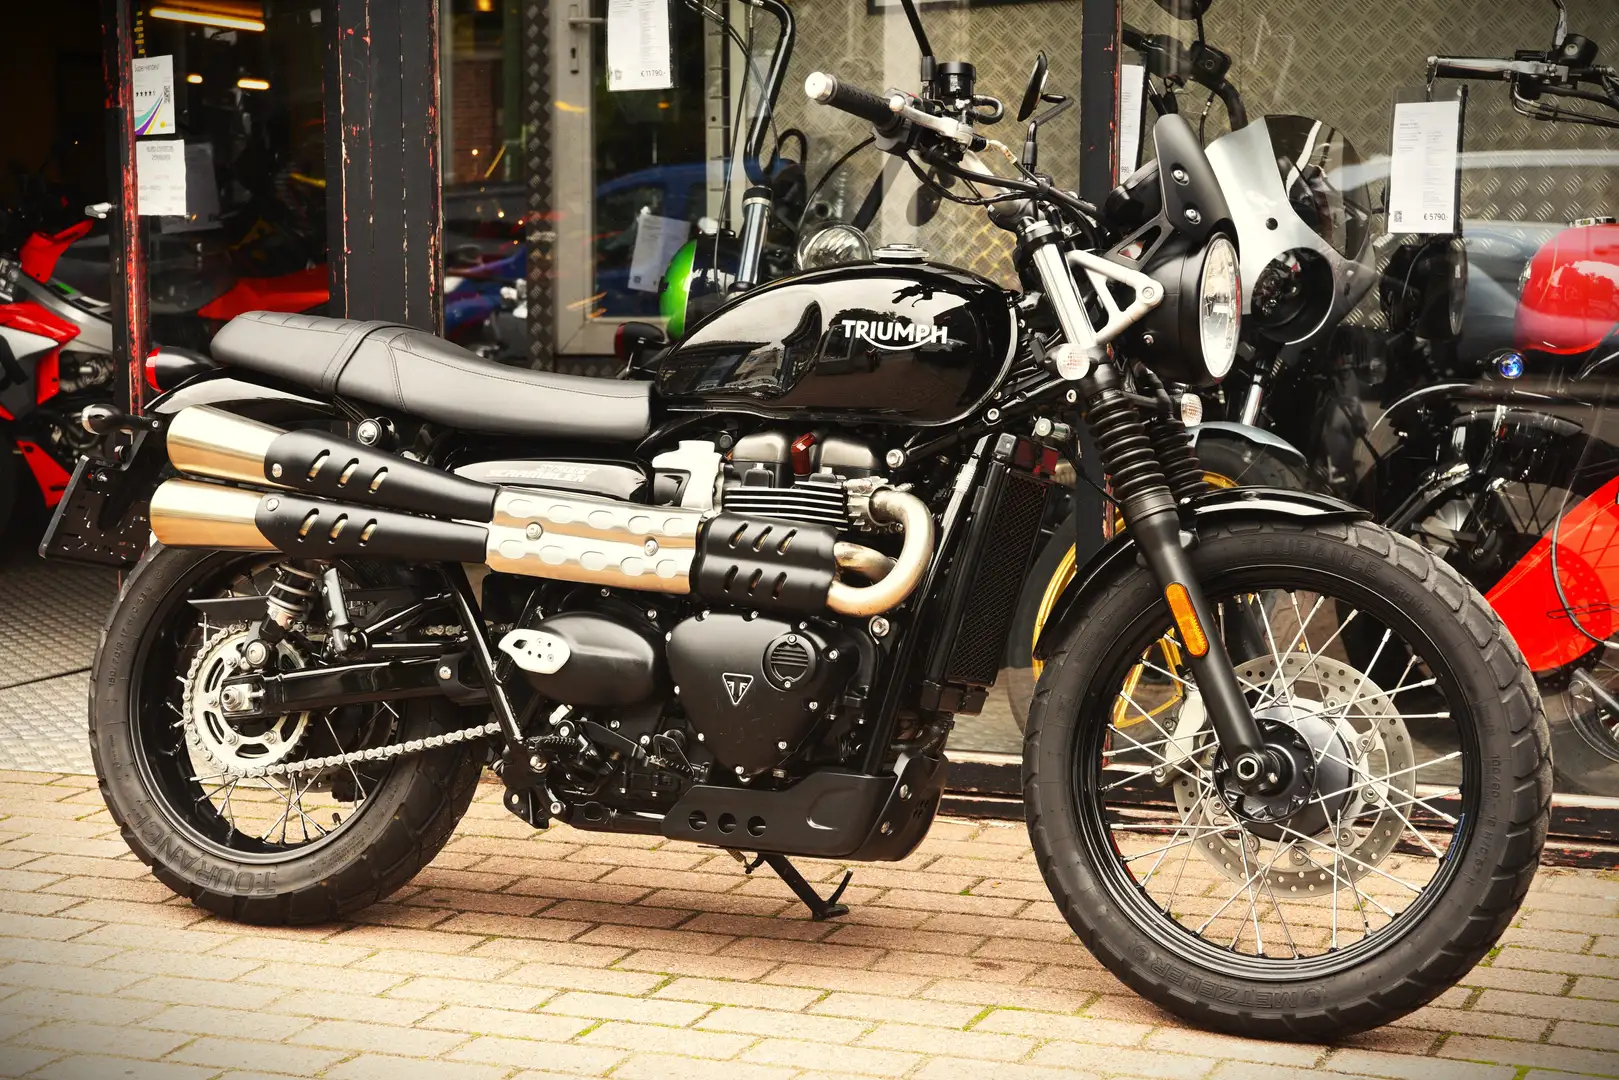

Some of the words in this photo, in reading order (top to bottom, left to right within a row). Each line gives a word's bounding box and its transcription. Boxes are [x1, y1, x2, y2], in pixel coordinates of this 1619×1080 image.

[842, 320, 948, 350] TRIUMPH
[1242, 537, 1382, 578] TOURANCE
[126, 798, 276, 894] TOURANCE
[1150, 955, 1299, 1009] METZELER
